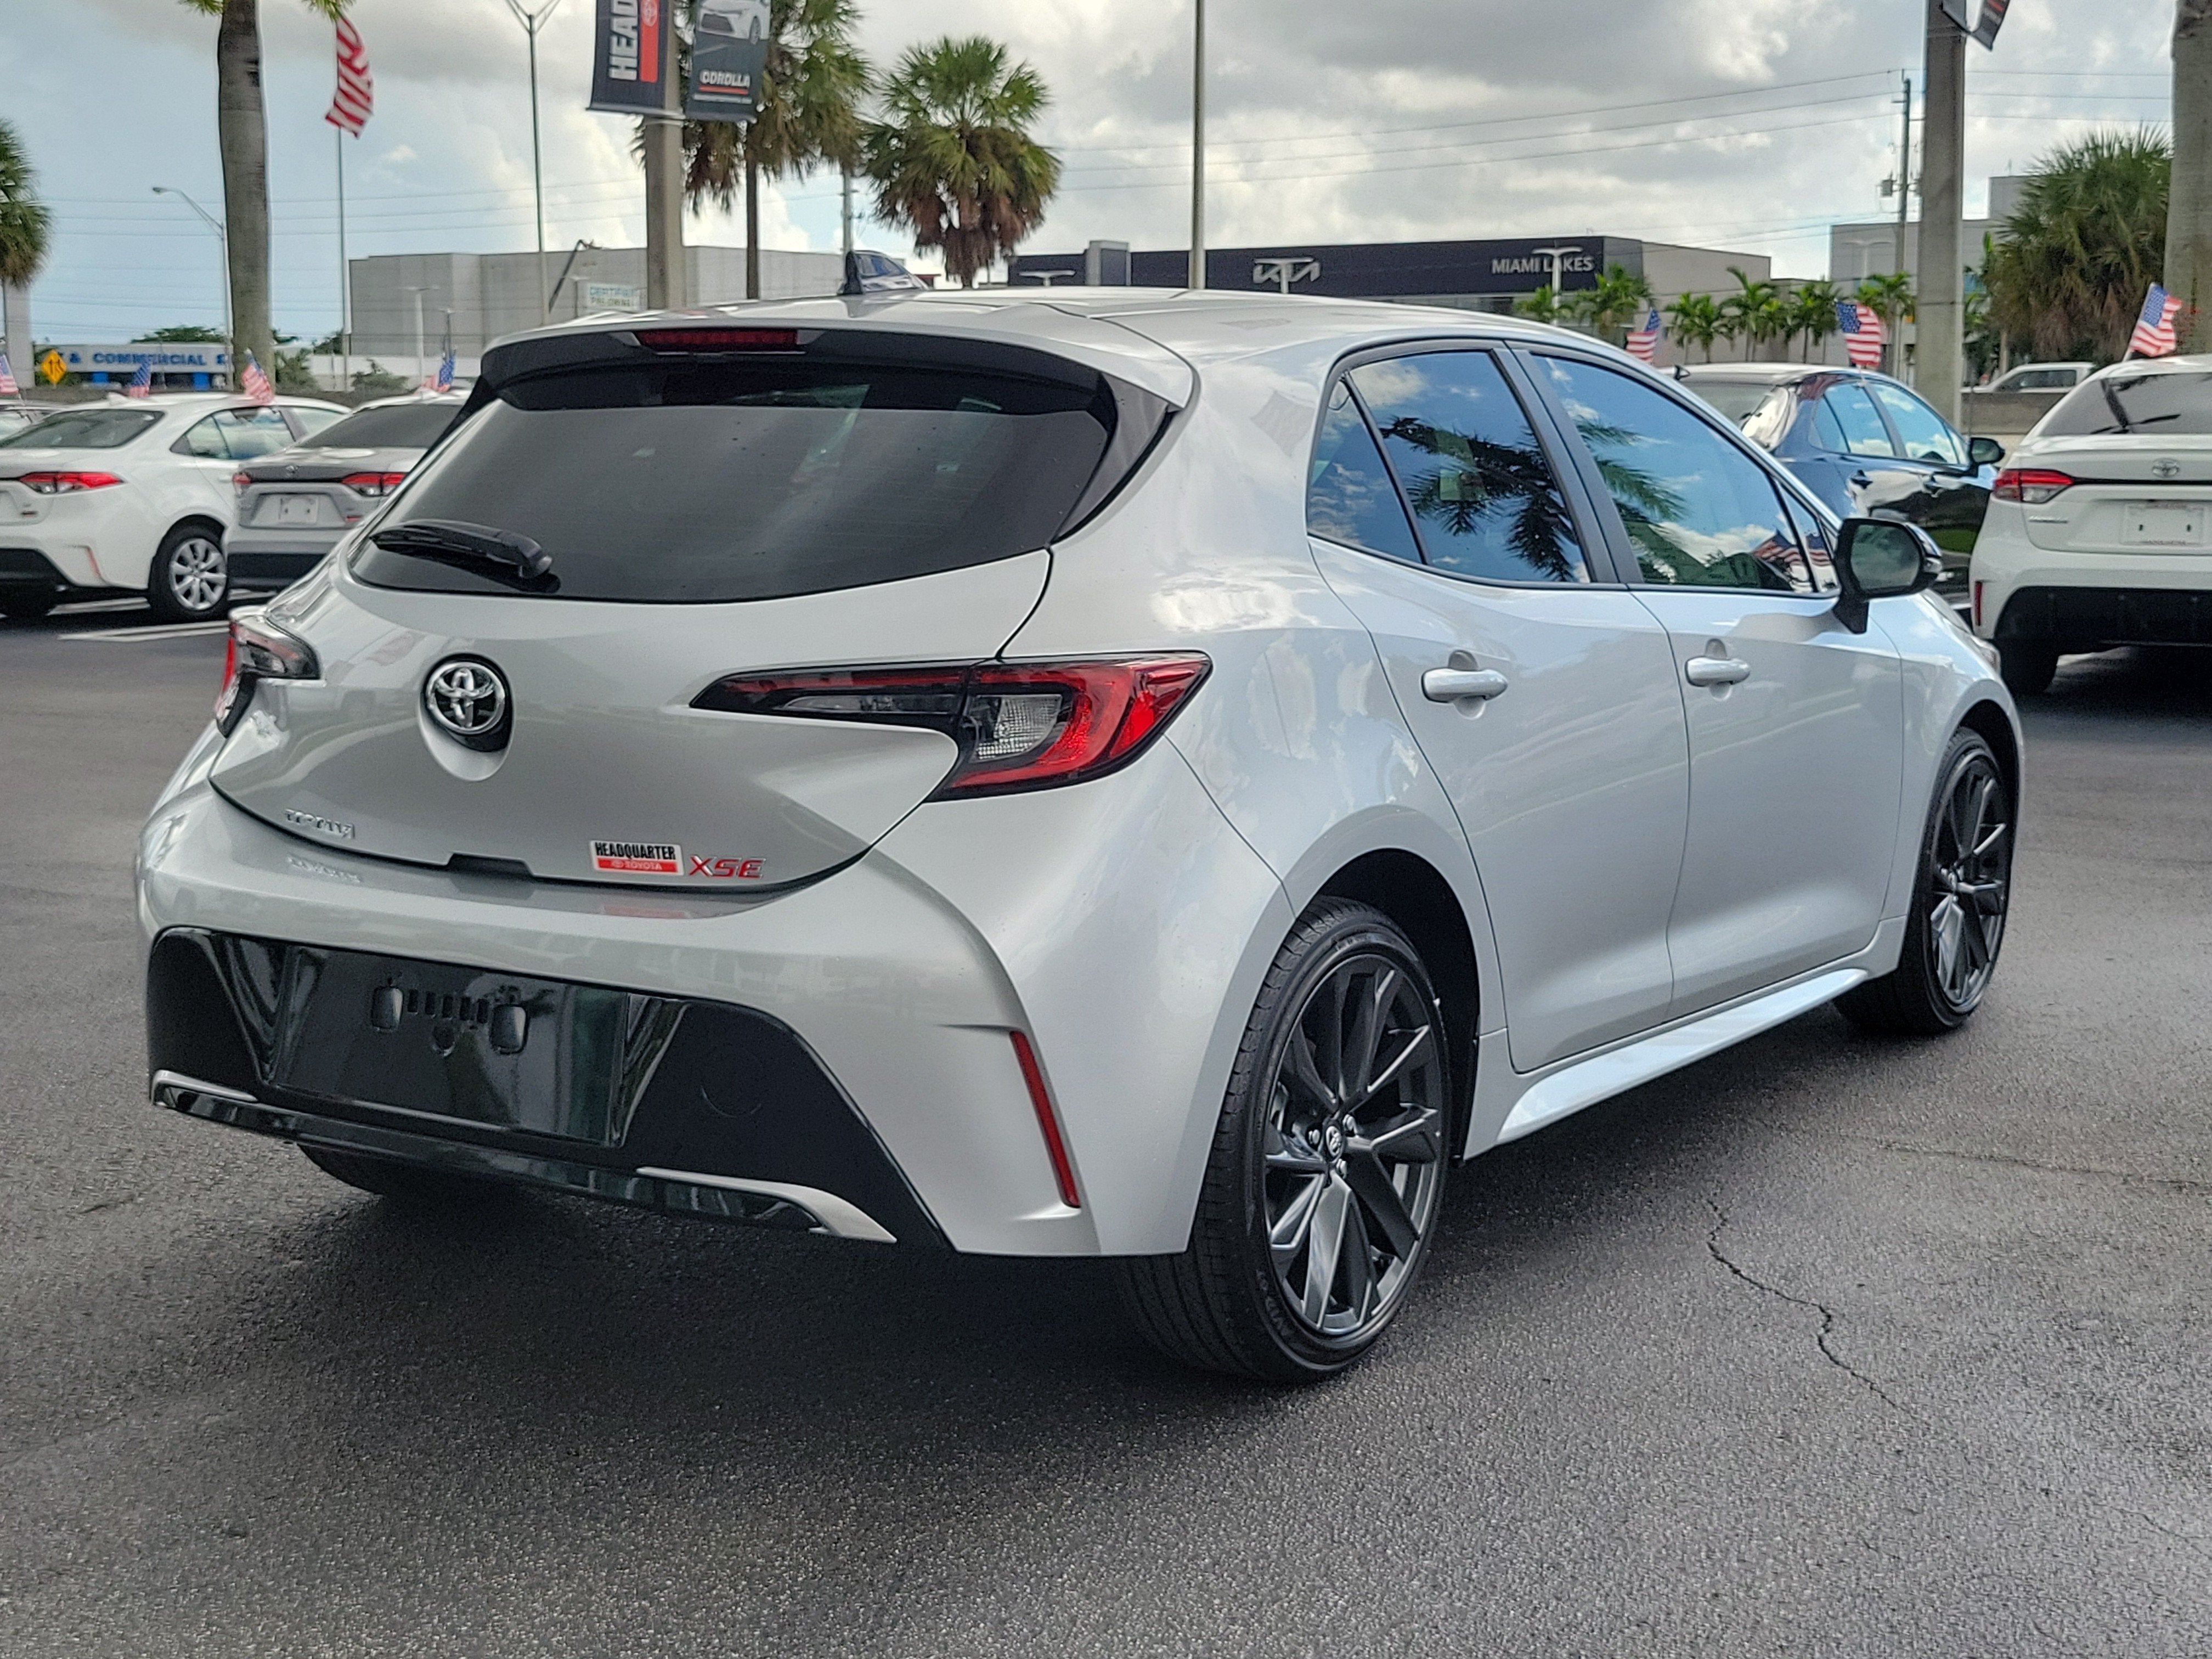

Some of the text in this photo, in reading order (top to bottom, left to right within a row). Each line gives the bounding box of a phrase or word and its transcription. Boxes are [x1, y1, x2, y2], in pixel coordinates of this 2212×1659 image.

[699, 69, 751, 88] COROLLA
[1492, 250, 1595, 274] MIAMI LKES
[69, 352, 82, 364] &
[595, 842, 676, 860] HEADQUARTER
[624, 860, 663, 871] TOYOTA
[689, 854, 766, 879] XSE
